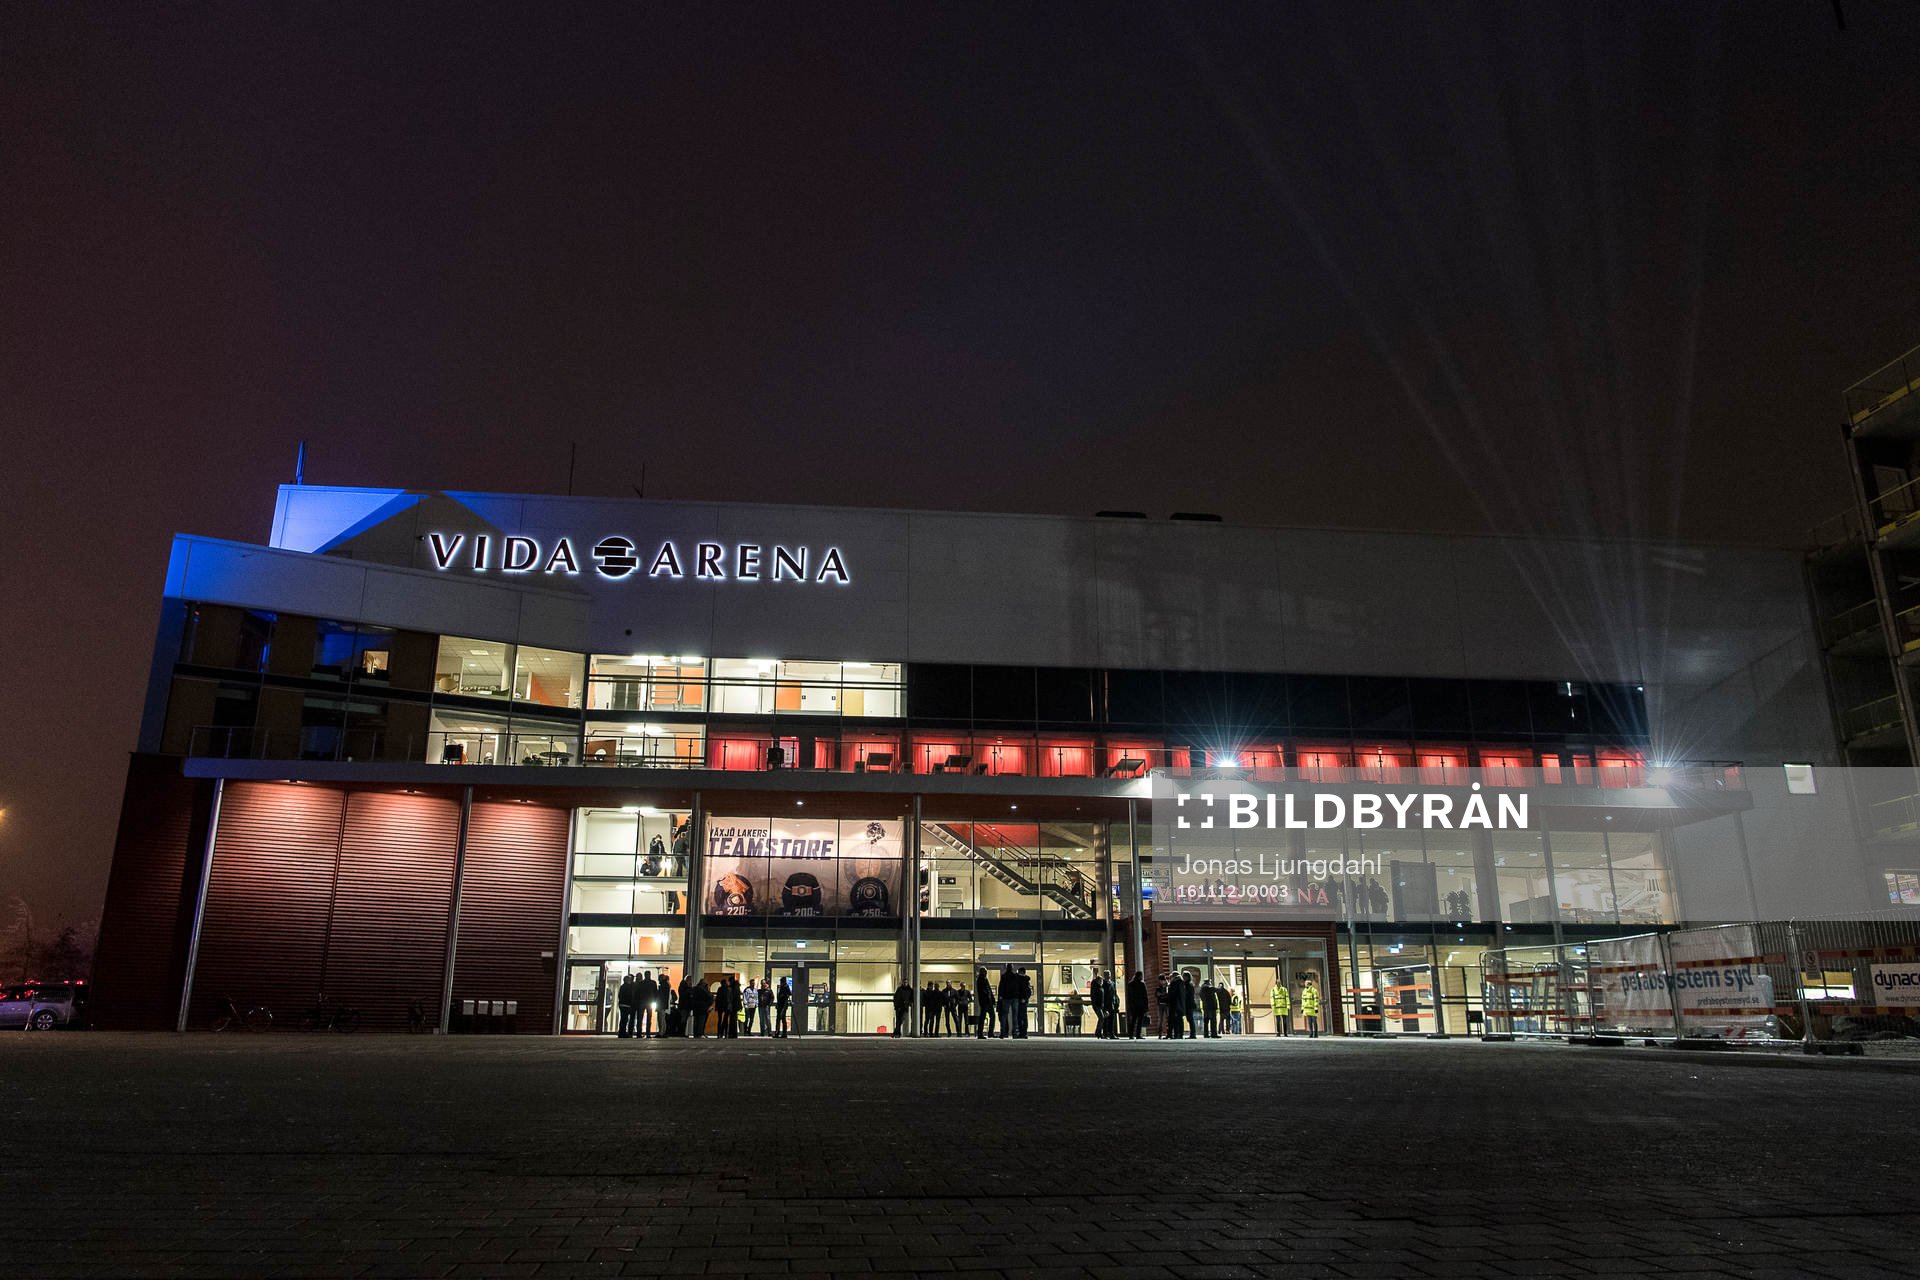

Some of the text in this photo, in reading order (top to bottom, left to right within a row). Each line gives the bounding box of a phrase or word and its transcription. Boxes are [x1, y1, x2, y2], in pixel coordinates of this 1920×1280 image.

[429, 532, 851, 584] VIDA ARENA
[737, 829, 768, 838] LAKERS
[709, 837, 834, 860] TEAMSTORE
[1724, 965, 1754, 992] syd
[1874, 969, 1920, 990] dynac
